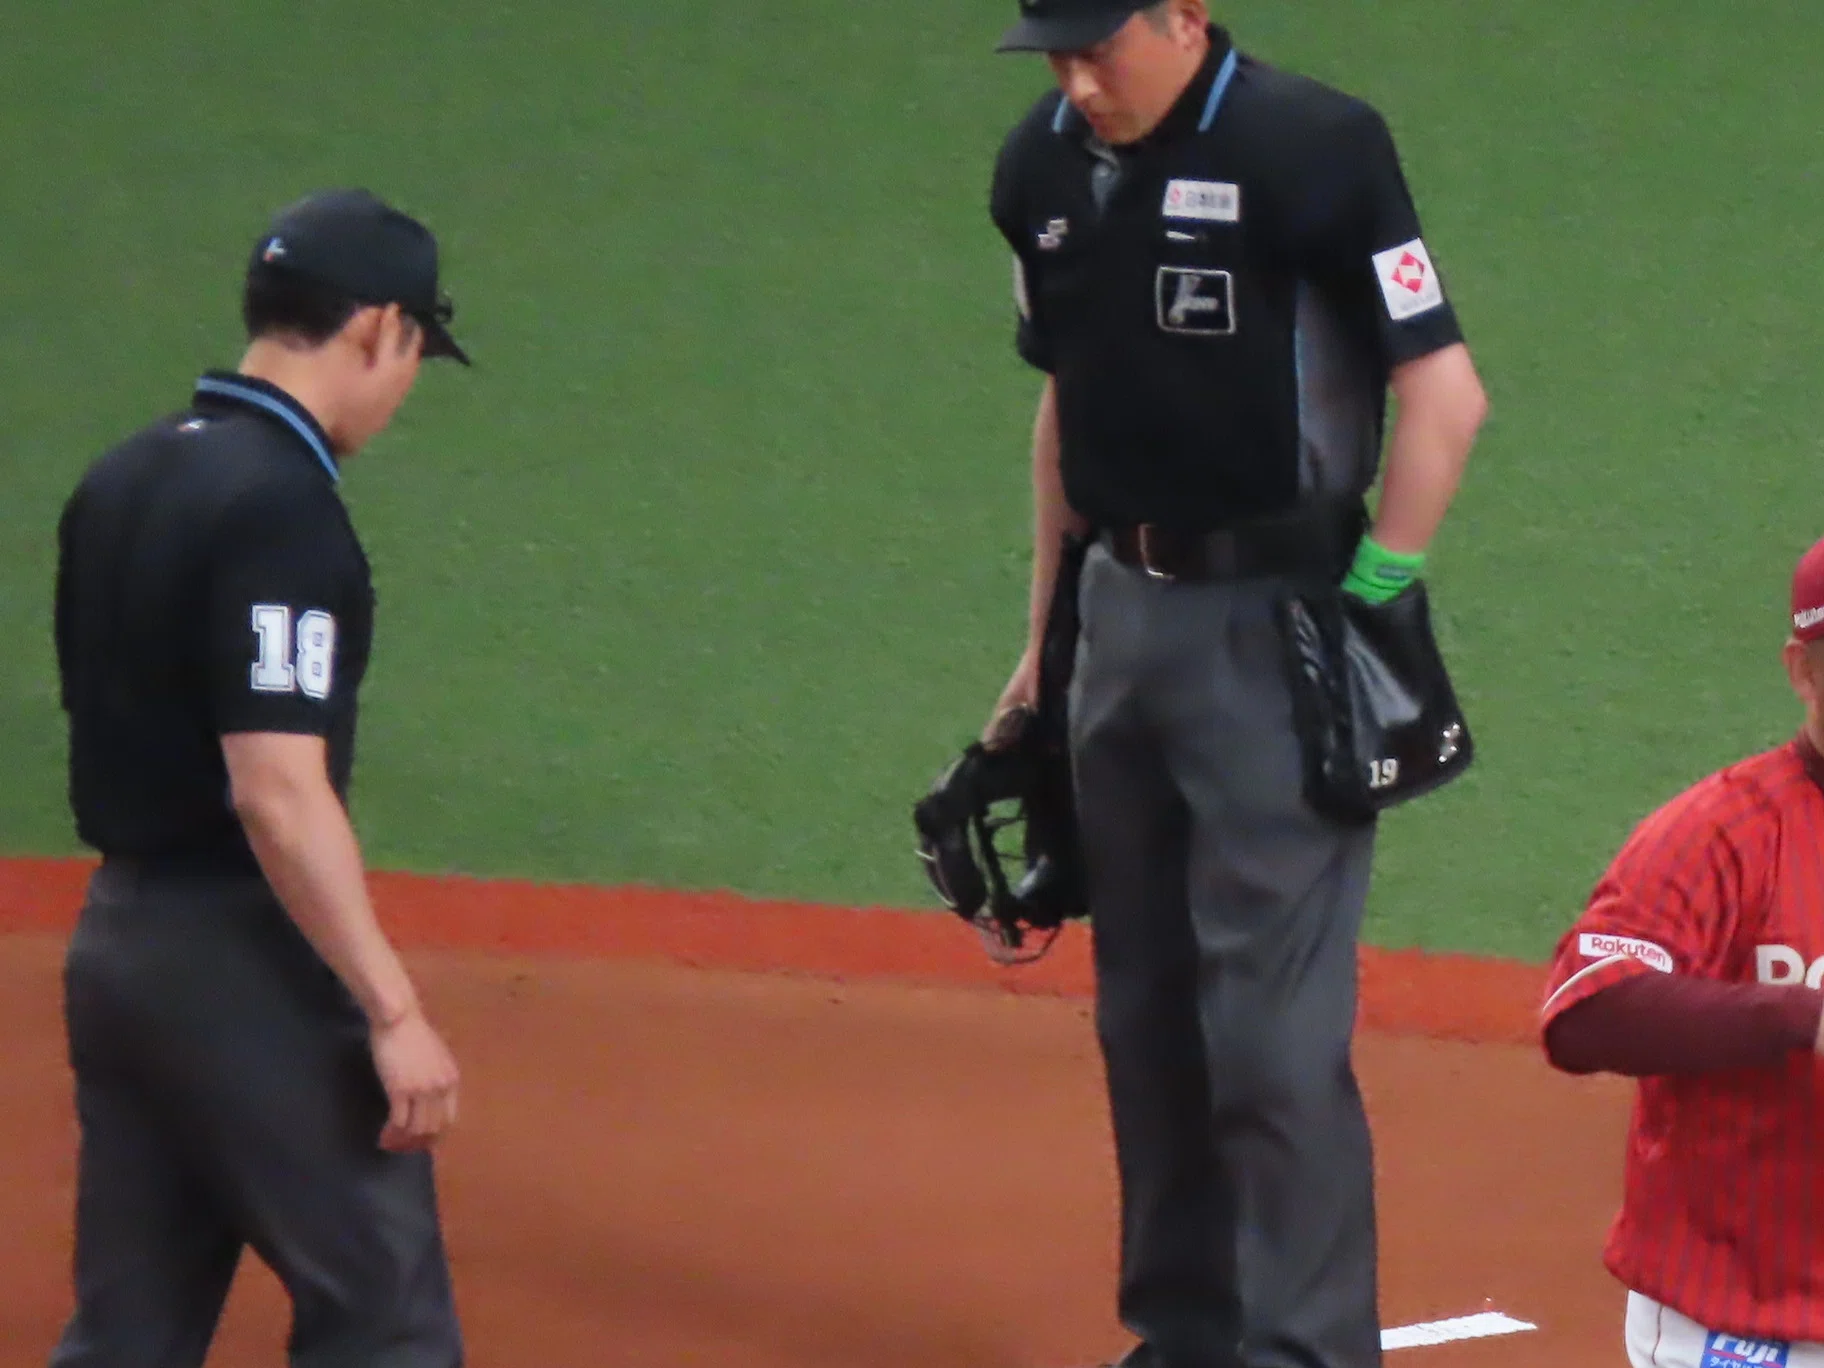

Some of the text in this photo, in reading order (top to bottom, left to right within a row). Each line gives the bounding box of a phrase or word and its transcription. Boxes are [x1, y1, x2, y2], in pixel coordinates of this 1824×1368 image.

[251, 604, 336, 698] 18
[1369, 758, 1399, 787] 19
[1591, 936, 1666, 967] Rakuten
